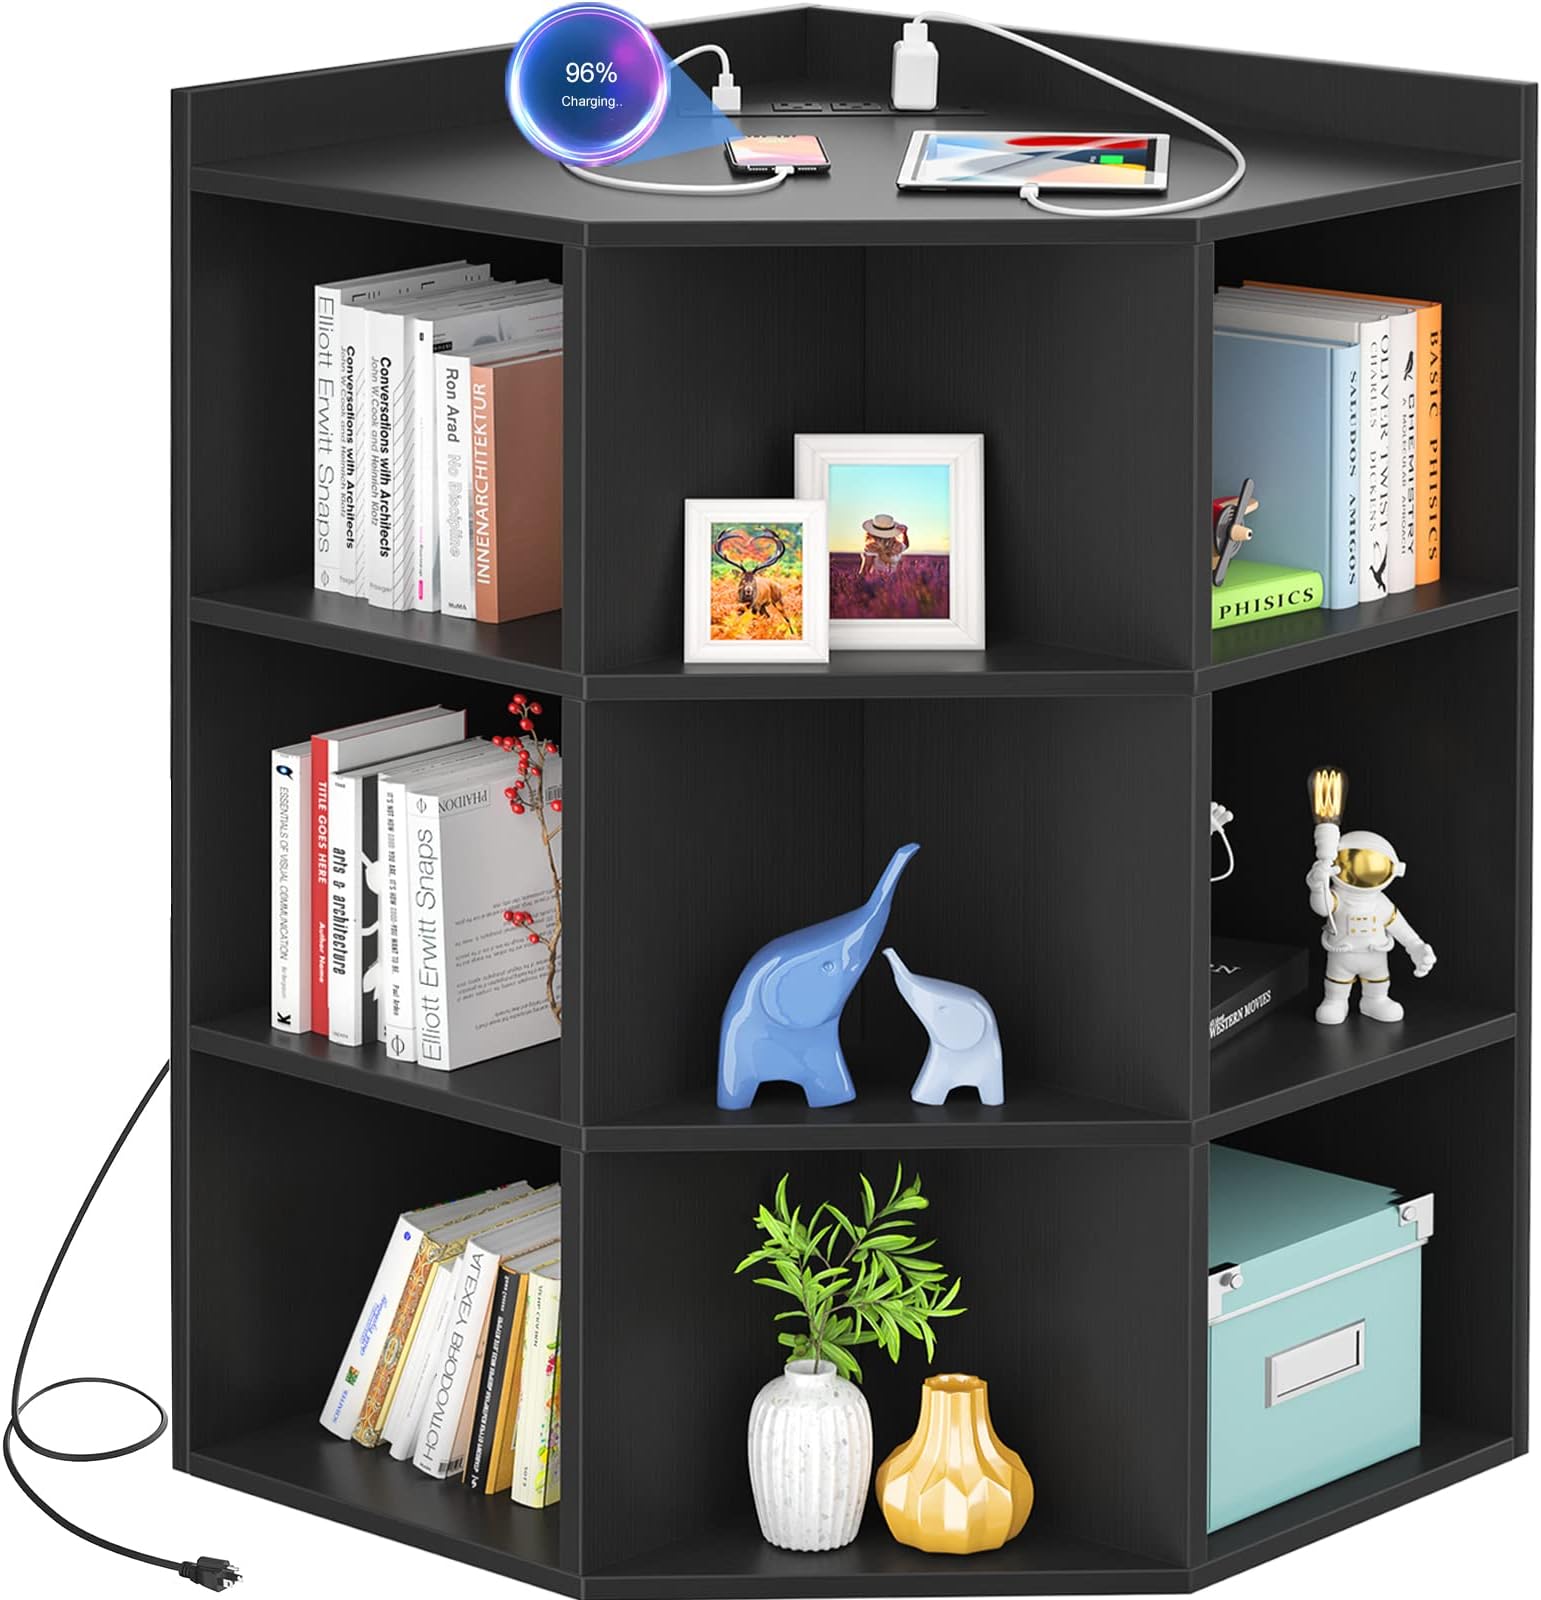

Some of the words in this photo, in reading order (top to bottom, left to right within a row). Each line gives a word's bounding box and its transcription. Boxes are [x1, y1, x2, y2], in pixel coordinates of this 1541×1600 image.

[318, 296, 335, 368] Elliott
[346, 345, 356, 444] Conversations
[380, 356, 391, 453] Conversations
[446, 368, 459, 400] Ron
[1370, 341, 1378, 428] CHARLES
[1380, 334, 1389, 440] OLIVER
[1428, 331, 1439, 417] BASIC
[318, 378, 335, 454] Erwitt
[447, 404, 460, 442] Arad
[1349, 371, 1357, 477] SALUDOS
[346, 448, 356, 476] with
[380, 457, 391, 486] with
[473, 383, 491, 584] INNENARCHITEKTUR
[1369, 451, 1377, 531] DICKENS
[1380, 445, 1388, 527] TWIST
[316, 463, 335, 553] Snaps
[346, 479, 356, 550] Architects
[380, 489, 391, 558] Architects
[1427, 439, 1439, 561] PHISICS
[1349, 494, 1357, 585] AMIGOS
[1219, 587, 1314, 621] PHISICS
[318, 781, 328, 811] TITLE
[439, 790, 488, 813] PHAIDON
[318, 814, 328, 849] GOES
[332, 847, 348, 874] arts
[318, 853, 328, 885] HERE
[415, 829, 439, 910] Snaps
[318, 921, 326, 953] Author
[318, 954, 326, 983] Name
[332, 894, 349, 976] architecture
[418, 919, 439, 988] Erwitt
[277, 1012, 291, 1025] K
[421, 995, 442, 1061] Elliott
[1209, 1007, 1244, 1039] WESTERN
[1243, 989, 1272, 1018] MOVIES
